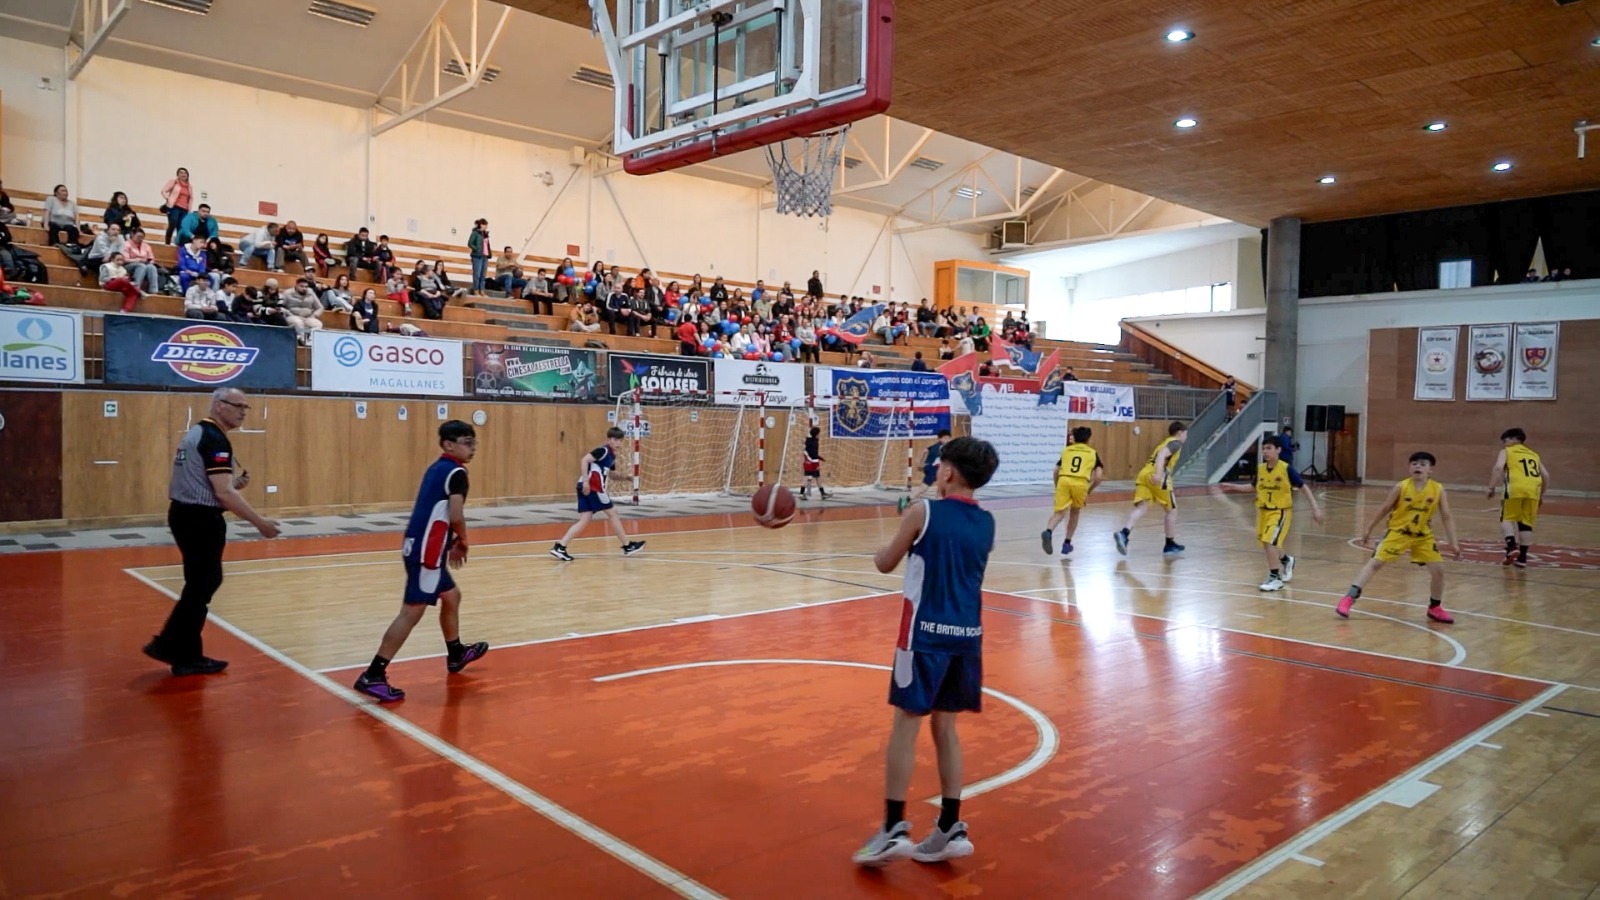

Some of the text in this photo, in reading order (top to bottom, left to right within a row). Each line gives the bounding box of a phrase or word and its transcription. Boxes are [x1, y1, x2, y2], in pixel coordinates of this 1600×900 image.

[162, 346, 249, 362] Dickies
[369, 378, 446, 390] MAGALLANES
[871, 376, 900, 385] Jugamos
[1071, 456, 1082, 473] 9
[1519, 458, 1539, 477] 13
[920, 621, 935, 633] THE
[936, 624, 965, 636] BRITISH
